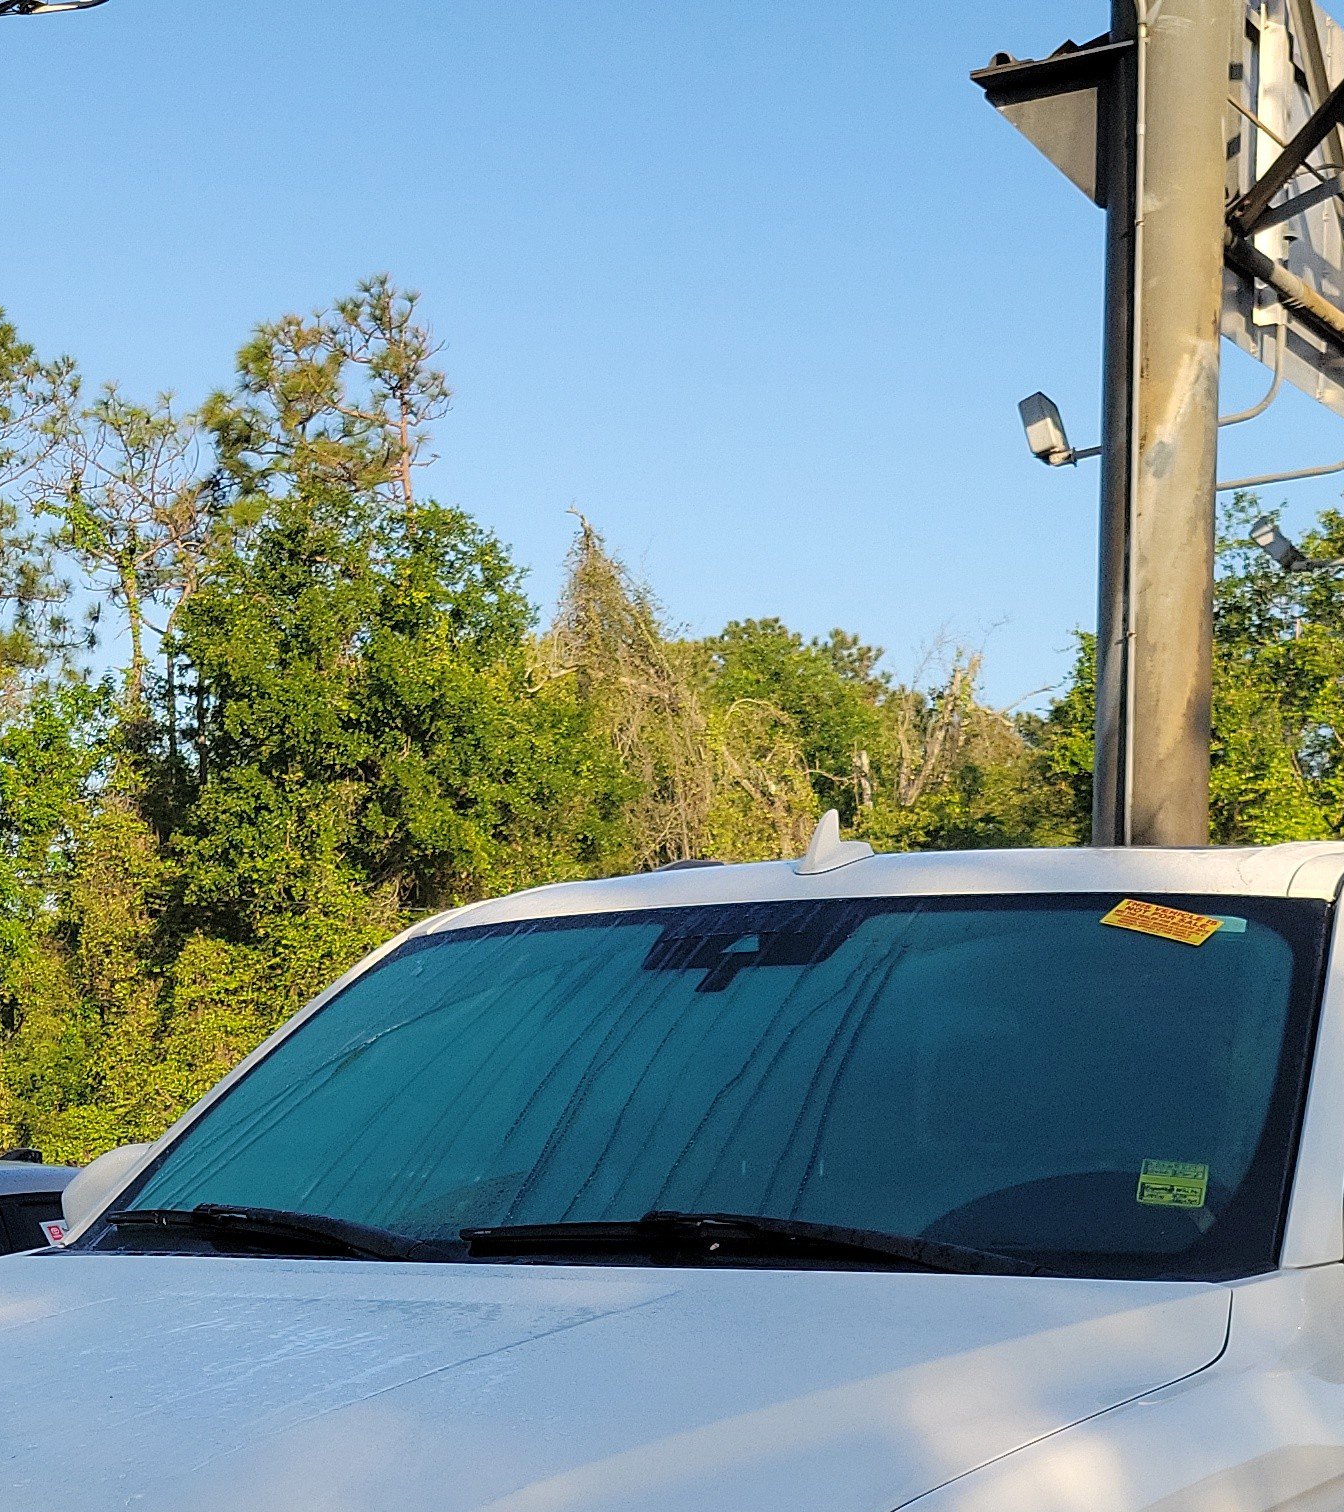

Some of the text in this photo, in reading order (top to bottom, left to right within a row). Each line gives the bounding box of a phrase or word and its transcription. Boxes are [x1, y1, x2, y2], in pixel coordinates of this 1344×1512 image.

[1124, 905, 1209, 929] NOT FOR SALE
[1125, 900, 1151, 910] THIS
[1154, 906, 1206, 921] VEHICLE
